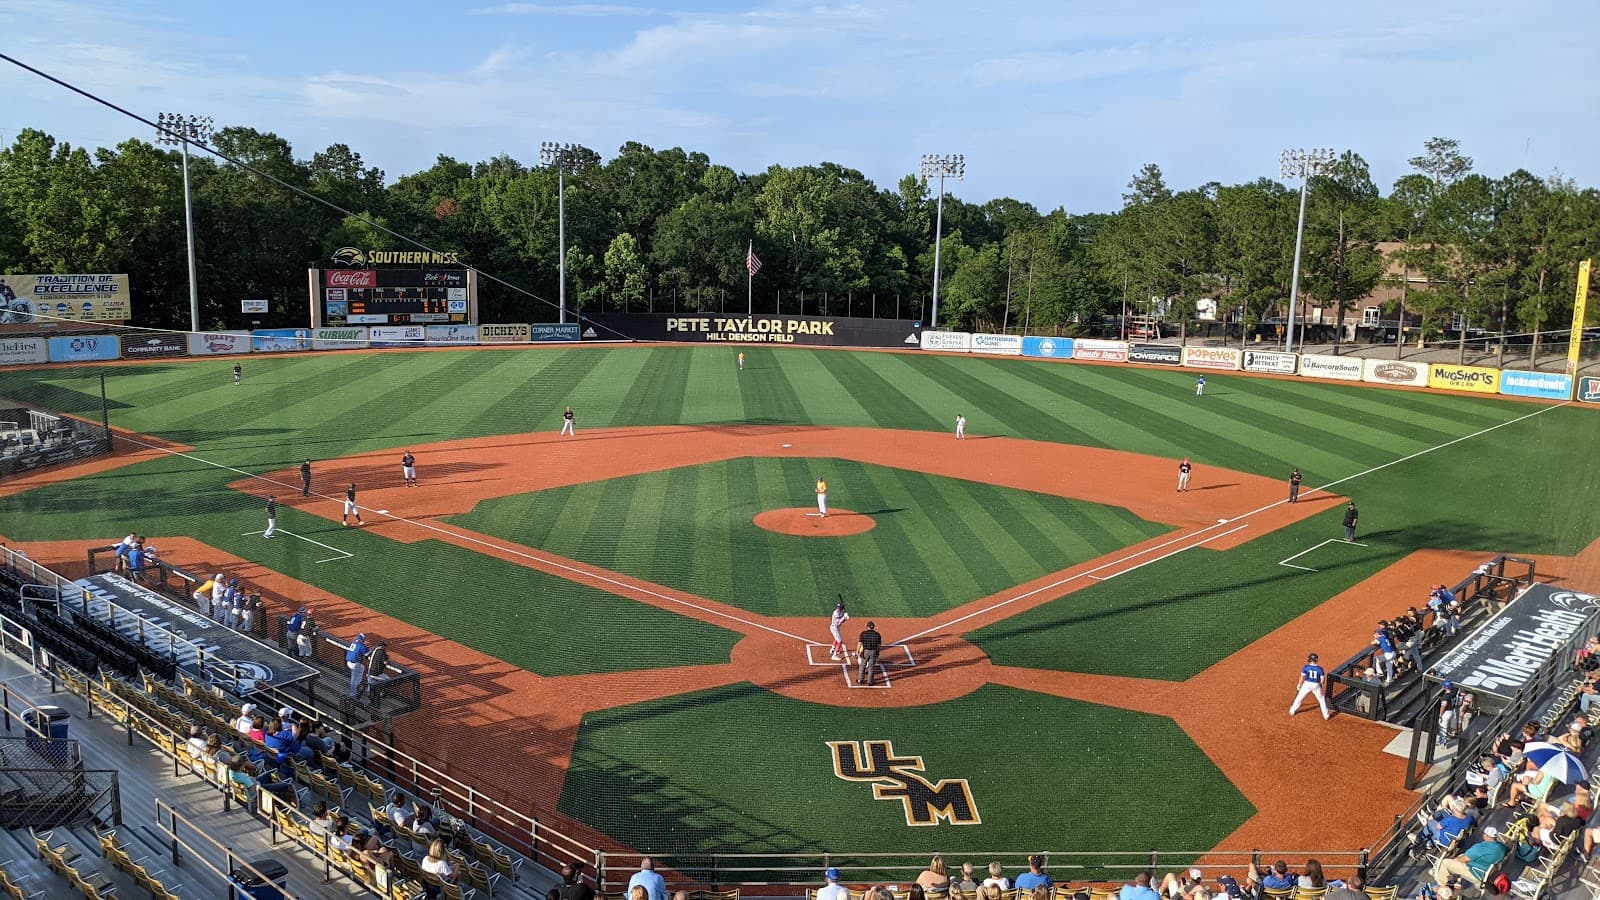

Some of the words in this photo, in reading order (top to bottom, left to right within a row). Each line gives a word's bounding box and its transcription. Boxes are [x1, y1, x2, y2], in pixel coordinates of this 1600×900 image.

[368, 251, 430, 264] SOUTHERN
[431, 252, 458, 265] MISS
[36, 275, 95, 283] TRADITION
[331, 271, 370, 286] Coca-Cola
[34, 284, 119, 294] EXCELLENCE
[483, 326, 528, 336] DICKEYS
[667, 318, 709, 331] PETE
[713, 318, 782, 333] TAYLOR
[787, 320, 834, 335] PARK
[319, 330, 361, 339] SUBWAY
[706, 333, 726, 341] HILL
[728, 333, 766, 342] DENSON
[769, 334, 794, 343] FIELD
[1129, 352, 1179, 361] POWERADE
[1311, 362, 1360, 372] BancorpSouth
[1513, 609, 1588, 653] Health
[1464, 636, 1490, 651] Southern
[1480, 628, 1499, 637] Miss
[1476, 641, 1551, 681] Merit
[1308, 670, 1318, 679] 11
[825, 740, 983, 827] USM
